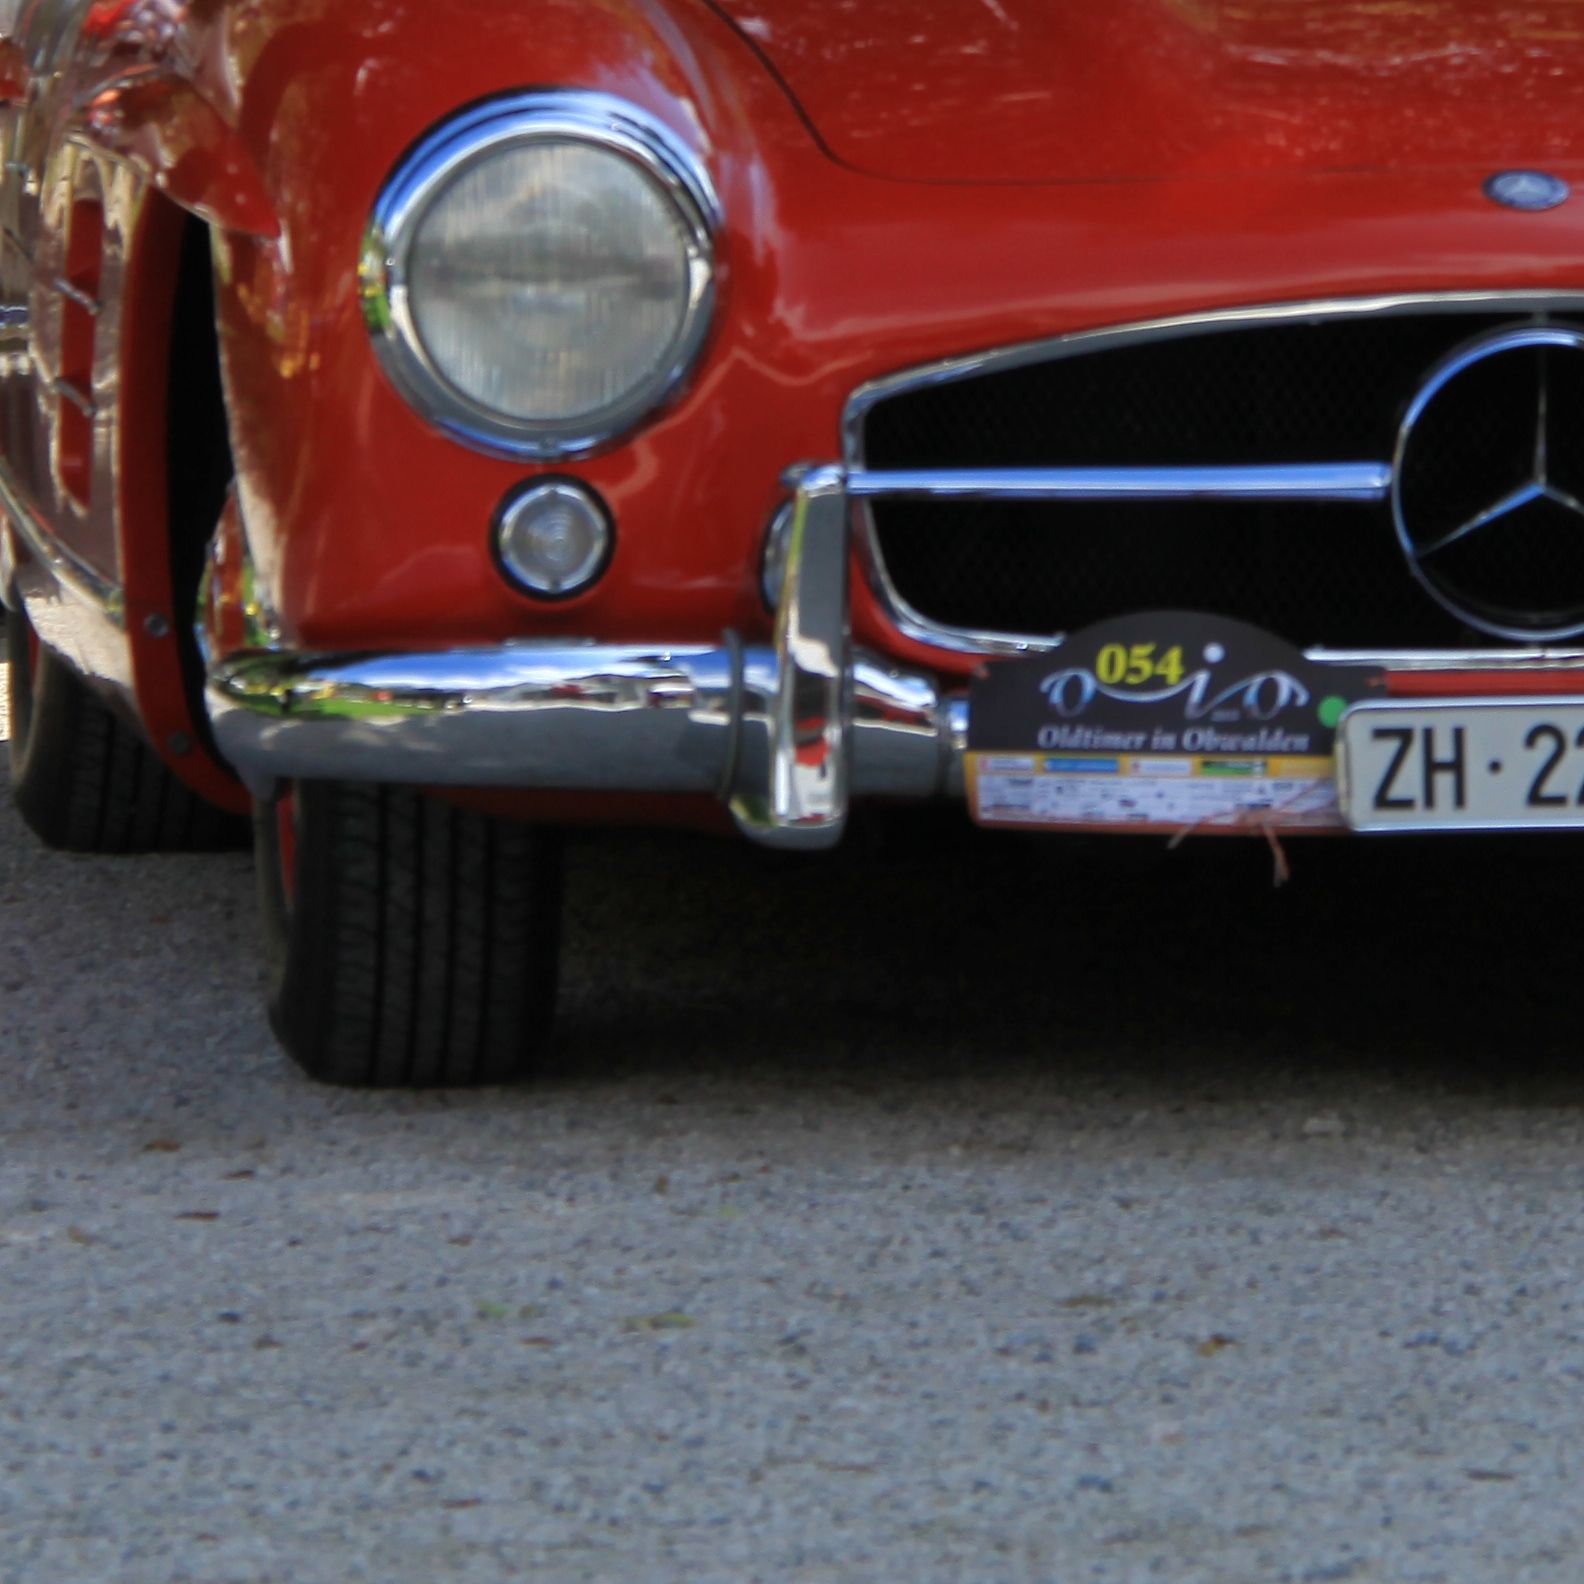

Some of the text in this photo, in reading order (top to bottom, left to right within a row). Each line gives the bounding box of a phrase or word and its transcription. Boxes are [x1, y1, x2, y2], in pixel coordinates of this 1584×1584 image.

[1095, 642, 1185, 685] 054
[1037, 723, 1310, 752] Oldtimer in Obwalden
